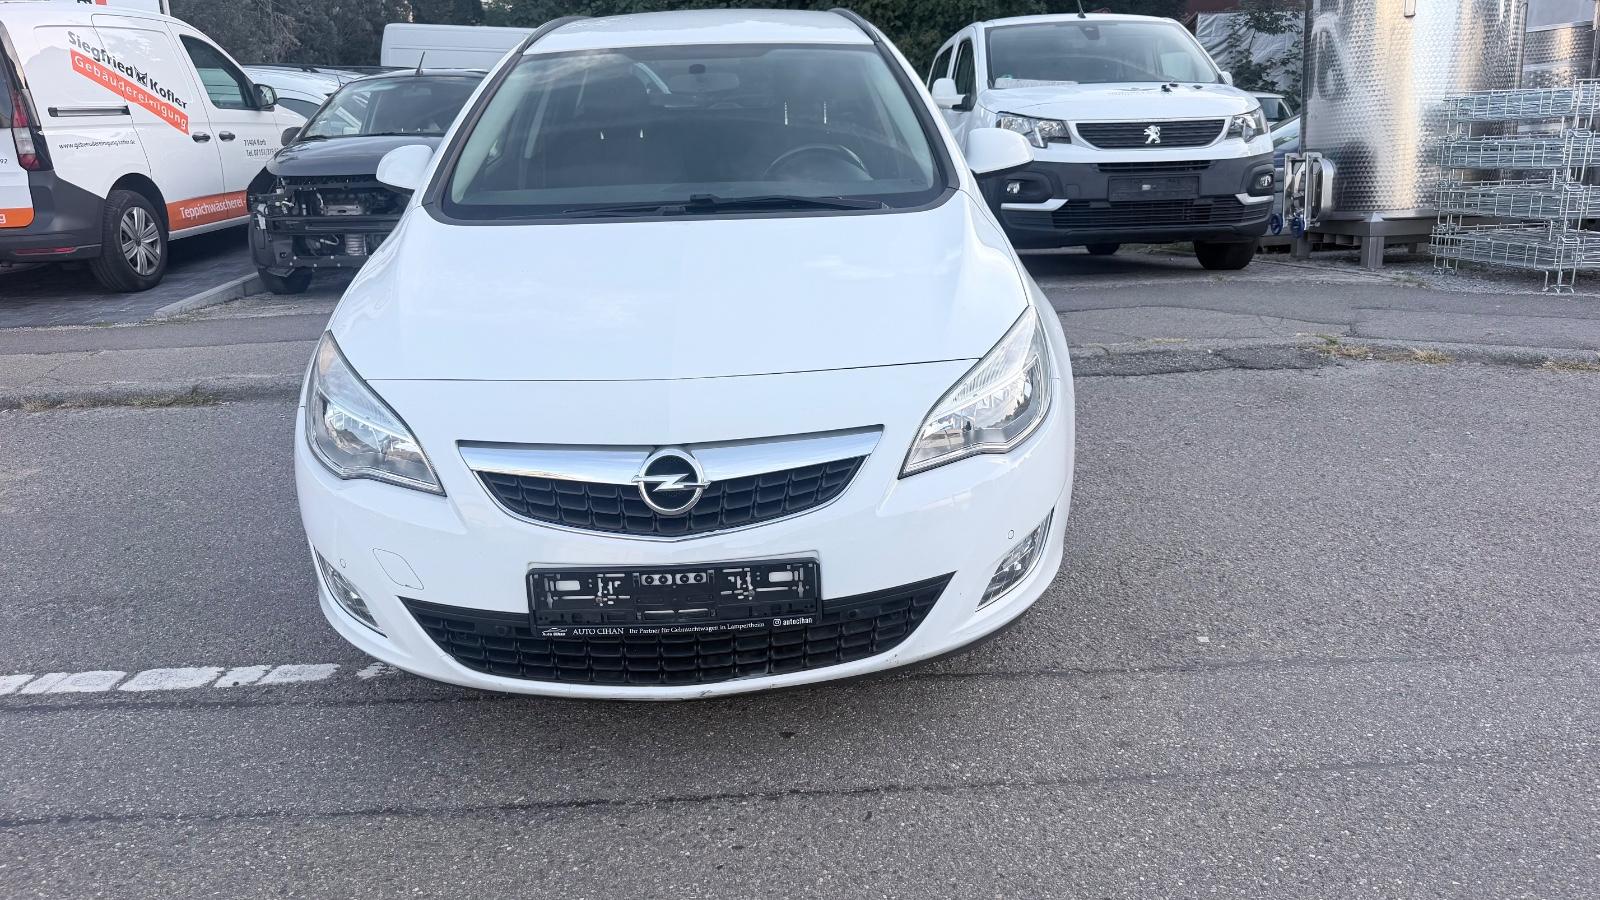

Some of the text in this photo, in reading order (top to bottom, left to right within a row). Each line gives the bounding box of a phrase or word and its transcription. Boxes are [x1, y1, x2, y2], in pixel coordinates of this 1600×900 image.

[68, 30, 134, 78] Siegfried
[150, 78, 188, 109] Kofler
[74, 55, 188, 130] Gebäudereinigung
[180, 196, 243, 220] Teppichwäscherei
[670, 624, 718, 632] Gebrauchtwagen
[720, 622, 727, 630] in
[727, 622, 765, 630] Lampertheim
[782, 616, 813, 626] autocihan
[596, 627, 625, 635] CIHAN
